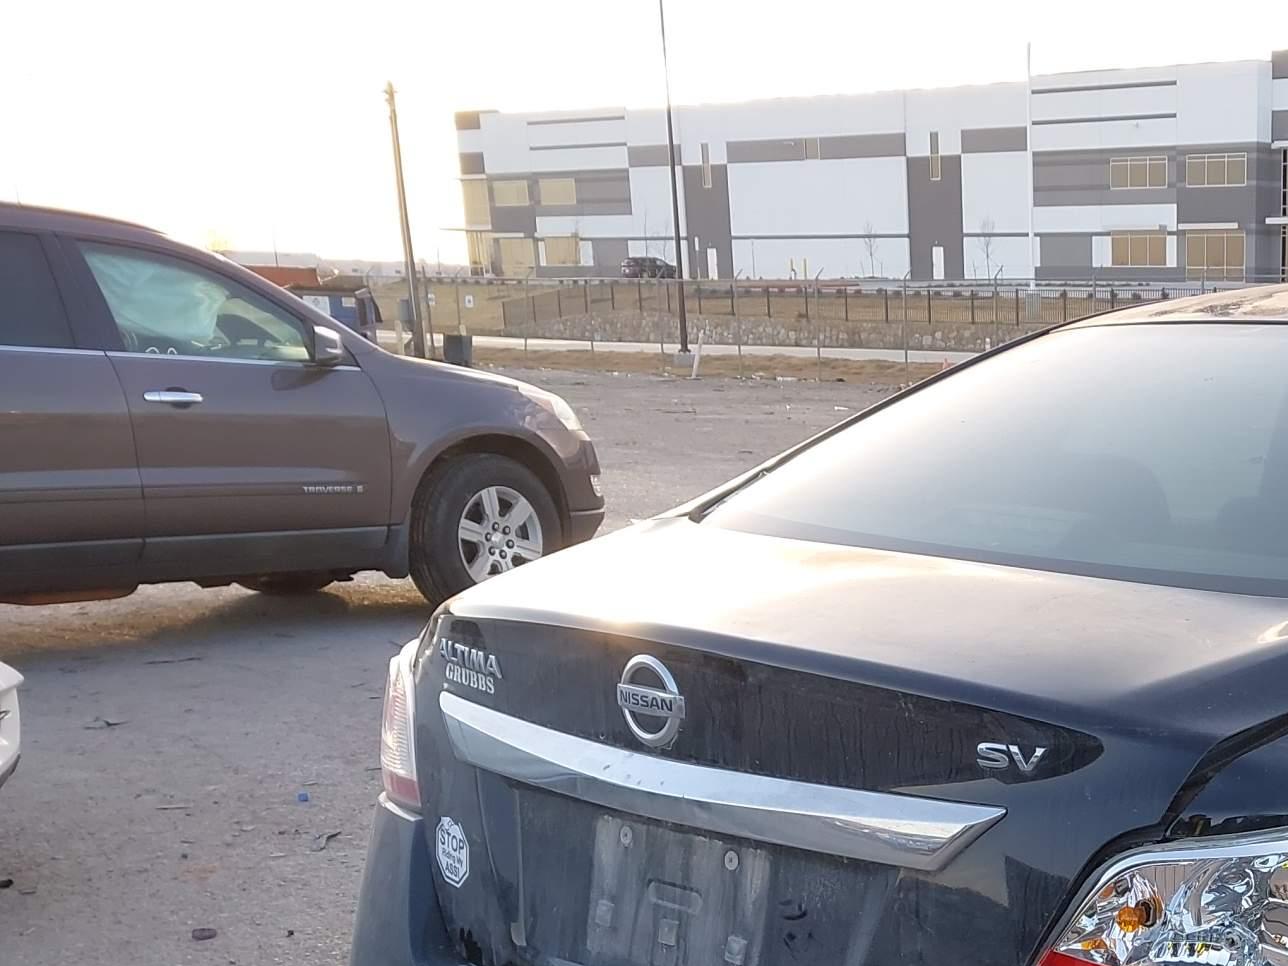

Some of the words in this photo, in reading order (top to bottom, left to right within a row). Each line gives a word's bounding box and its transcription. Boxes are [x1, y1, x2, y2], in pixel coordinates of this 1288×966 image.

[440, 638, 503, 680] ALTIMA
[445, 662, 495, 694] GRUBBS
[620, 690, 673, 712] NISSAN
[976, 742, 1047, 771] SV
[440, 828, 464, 855] STOP
